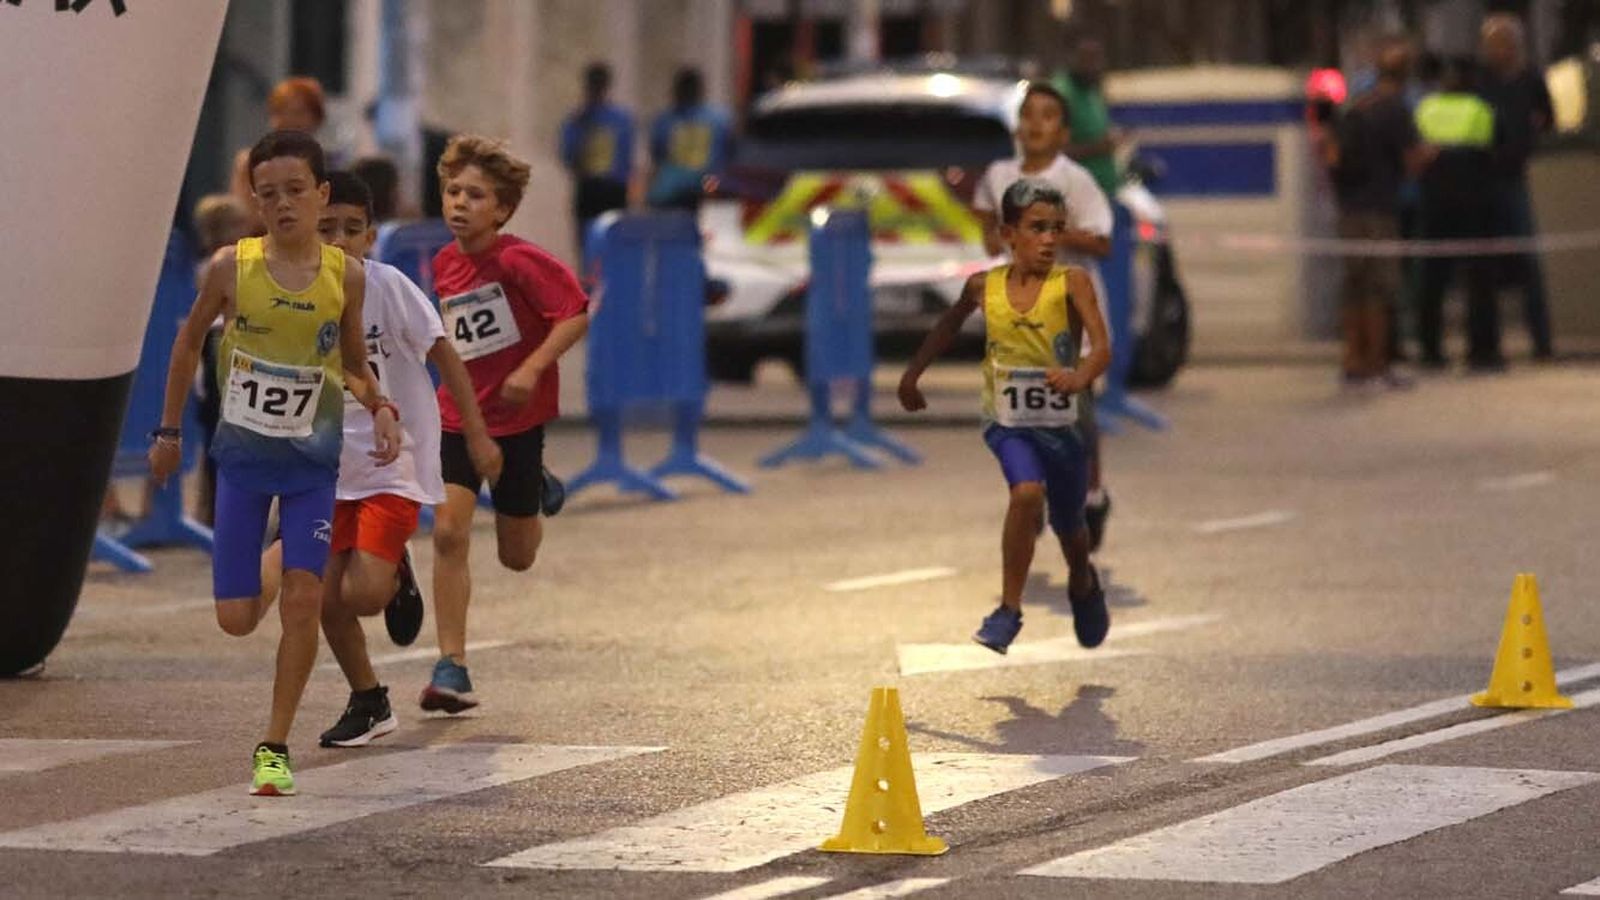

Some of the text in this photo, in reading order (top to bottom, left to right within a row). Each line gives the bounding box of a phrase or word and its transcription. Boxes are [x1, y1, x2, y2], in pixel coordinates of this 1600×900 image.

[455, 309, 501, 343] 42
[241, 379, 313, 417] 127
[1002, 386, 1071, 410] 163
